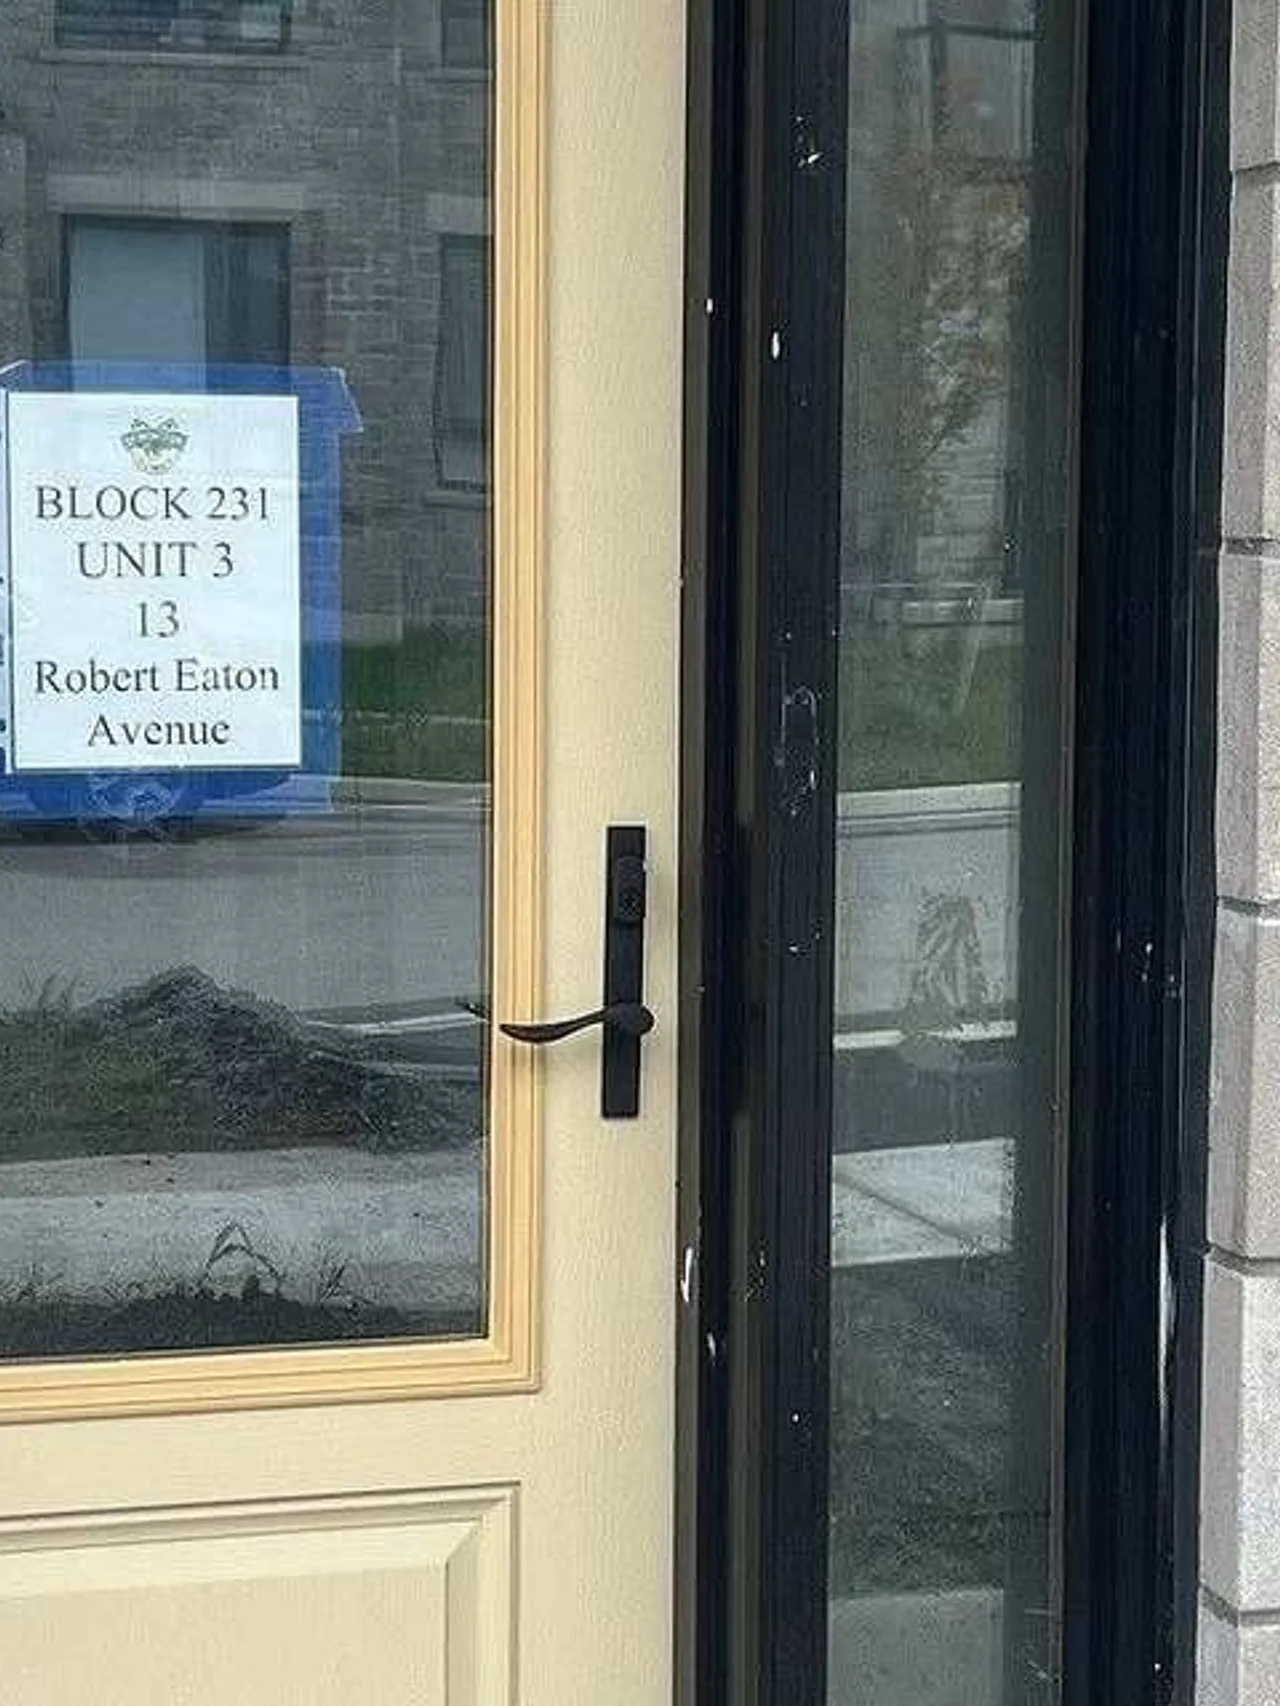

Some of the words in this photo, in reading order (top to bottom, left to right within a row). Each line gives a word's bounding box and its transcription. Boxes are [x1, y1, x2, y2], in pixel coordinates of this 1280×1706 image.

[35, 486, 192, 522] BLOCK
[206, 486, 269, 522] 231
[77, 541, 198, 579] UNIT
[213, 541, 235, 579] 3
[137, 601, 180, 639] 13
[35, 659, 160, 694] Robert
[175, 658, 280, 693] Eaton
[88, 714, 231, 747] Avenue
